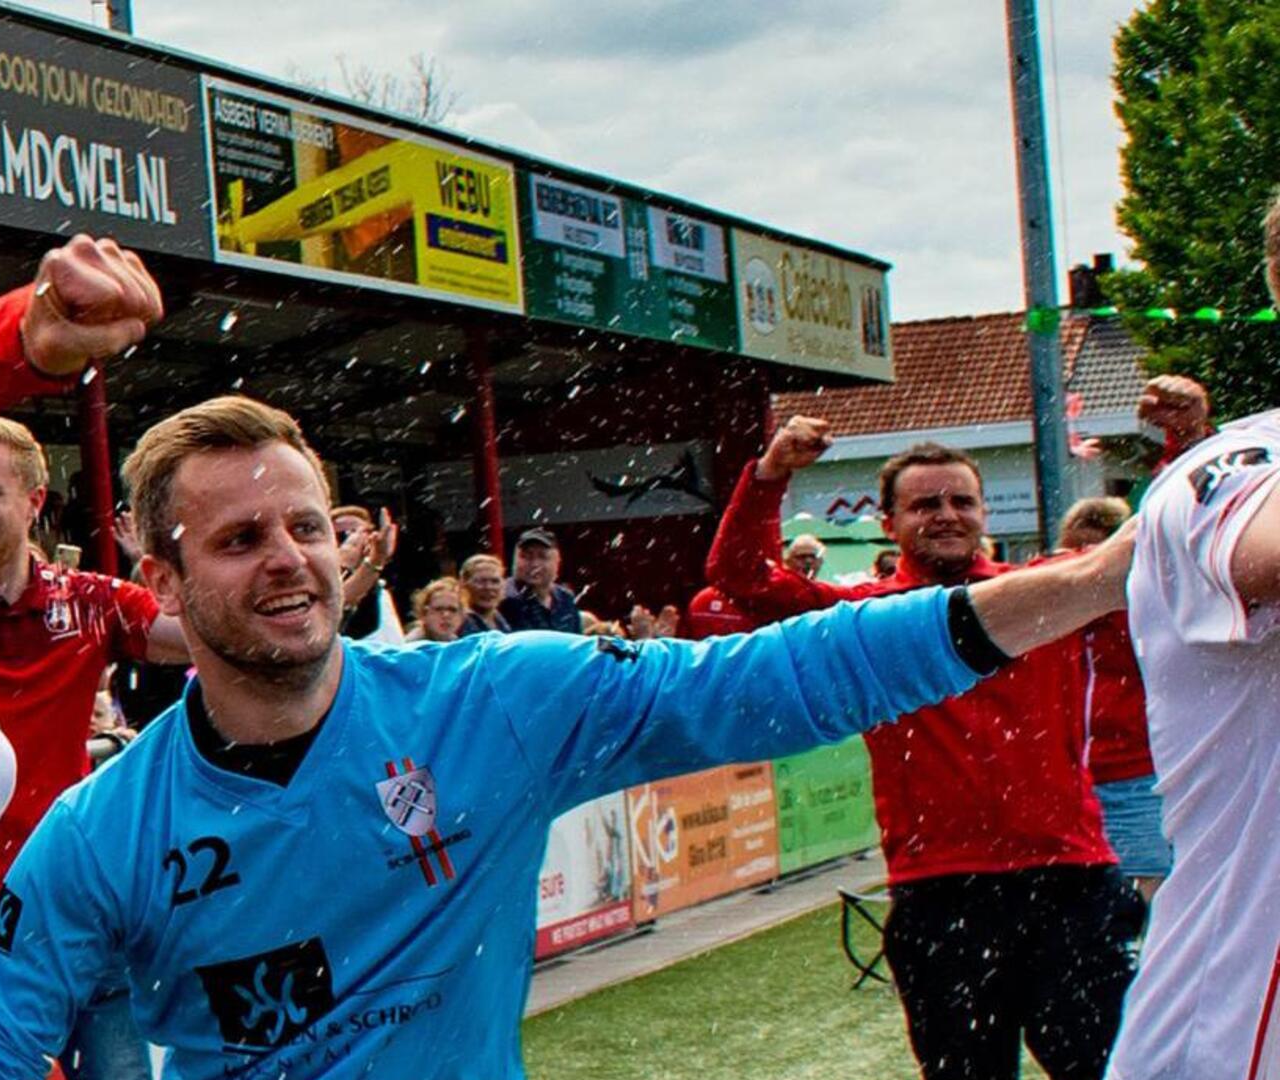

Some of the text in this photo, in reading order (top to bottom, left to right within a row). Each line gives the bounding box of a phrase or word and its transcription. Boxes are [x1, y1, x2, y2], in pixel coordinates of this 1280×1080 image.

[39, 63, 89, 108] JOUW
[92, 76, 189, 133] GEZONDHEID
[436, 159, 491, 218] WEBU
[161, 834, 240, 906] 22
